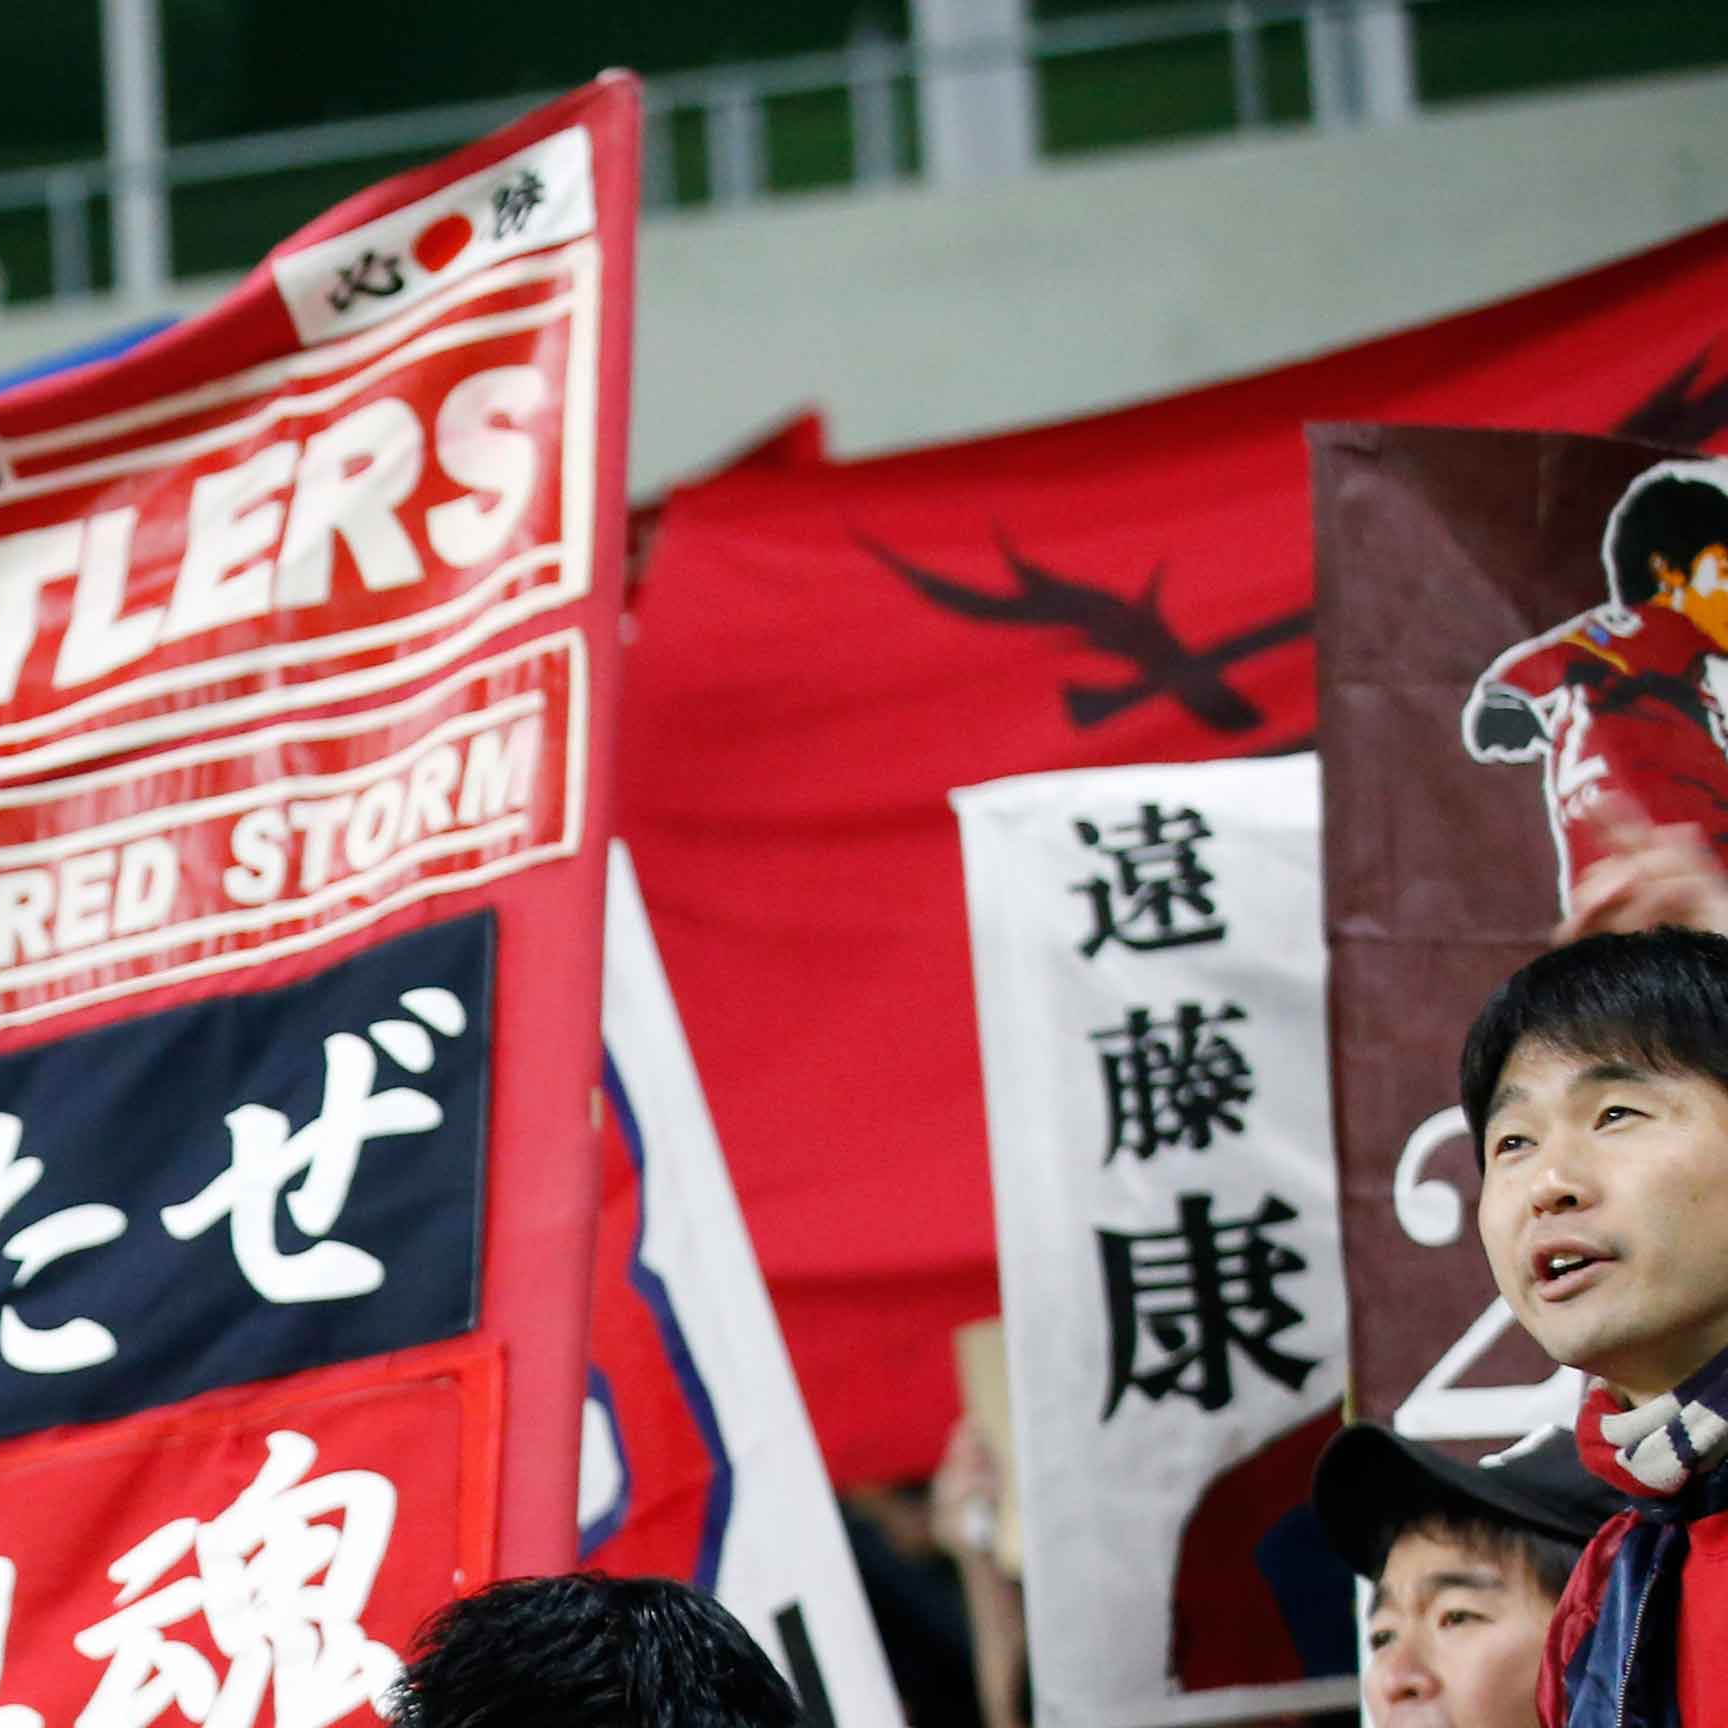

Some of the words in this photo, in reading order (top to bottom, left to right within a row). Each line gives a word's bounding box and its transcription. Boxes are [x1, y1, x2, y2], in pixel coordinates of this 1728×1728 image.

[224, 712, 539, 905] STORM
[1068, 802, 1324, 1422] 遠藤康
